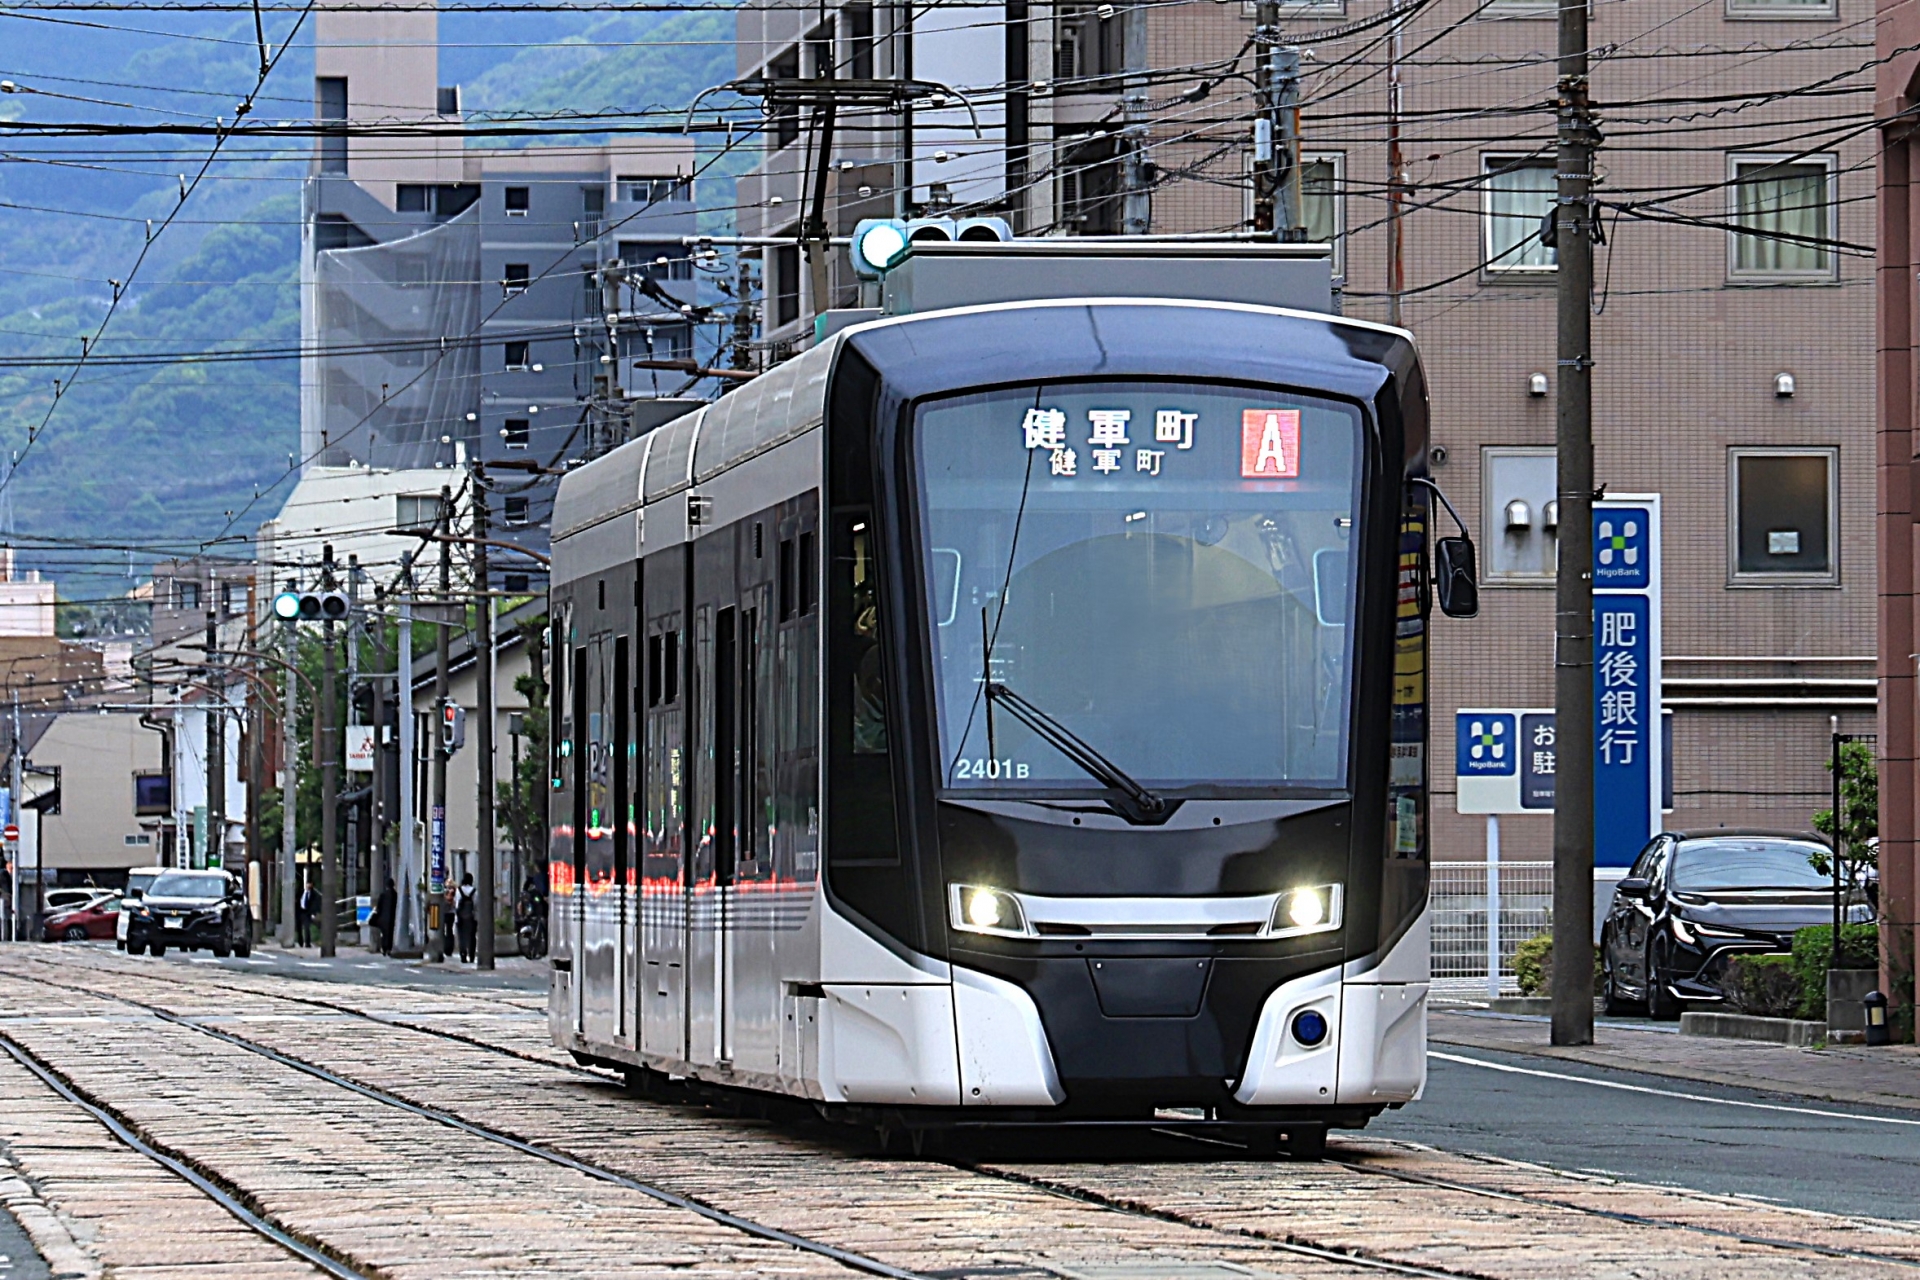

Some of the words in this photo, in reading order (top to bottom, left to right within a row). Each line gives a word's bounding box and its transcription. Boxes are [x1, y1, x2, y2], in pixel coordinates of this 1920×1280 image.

[1022, 408, 1198, 449] 健軍町
[1254, 413, 1287, 472] A
[1049, 448, 1165, 476] 健軍町
[1596, 568, 1641, 578] HigoBank
[1599, 612, 1638, 765] 肥後銀行
[1469, 761, 1507, 770] HigoBank
